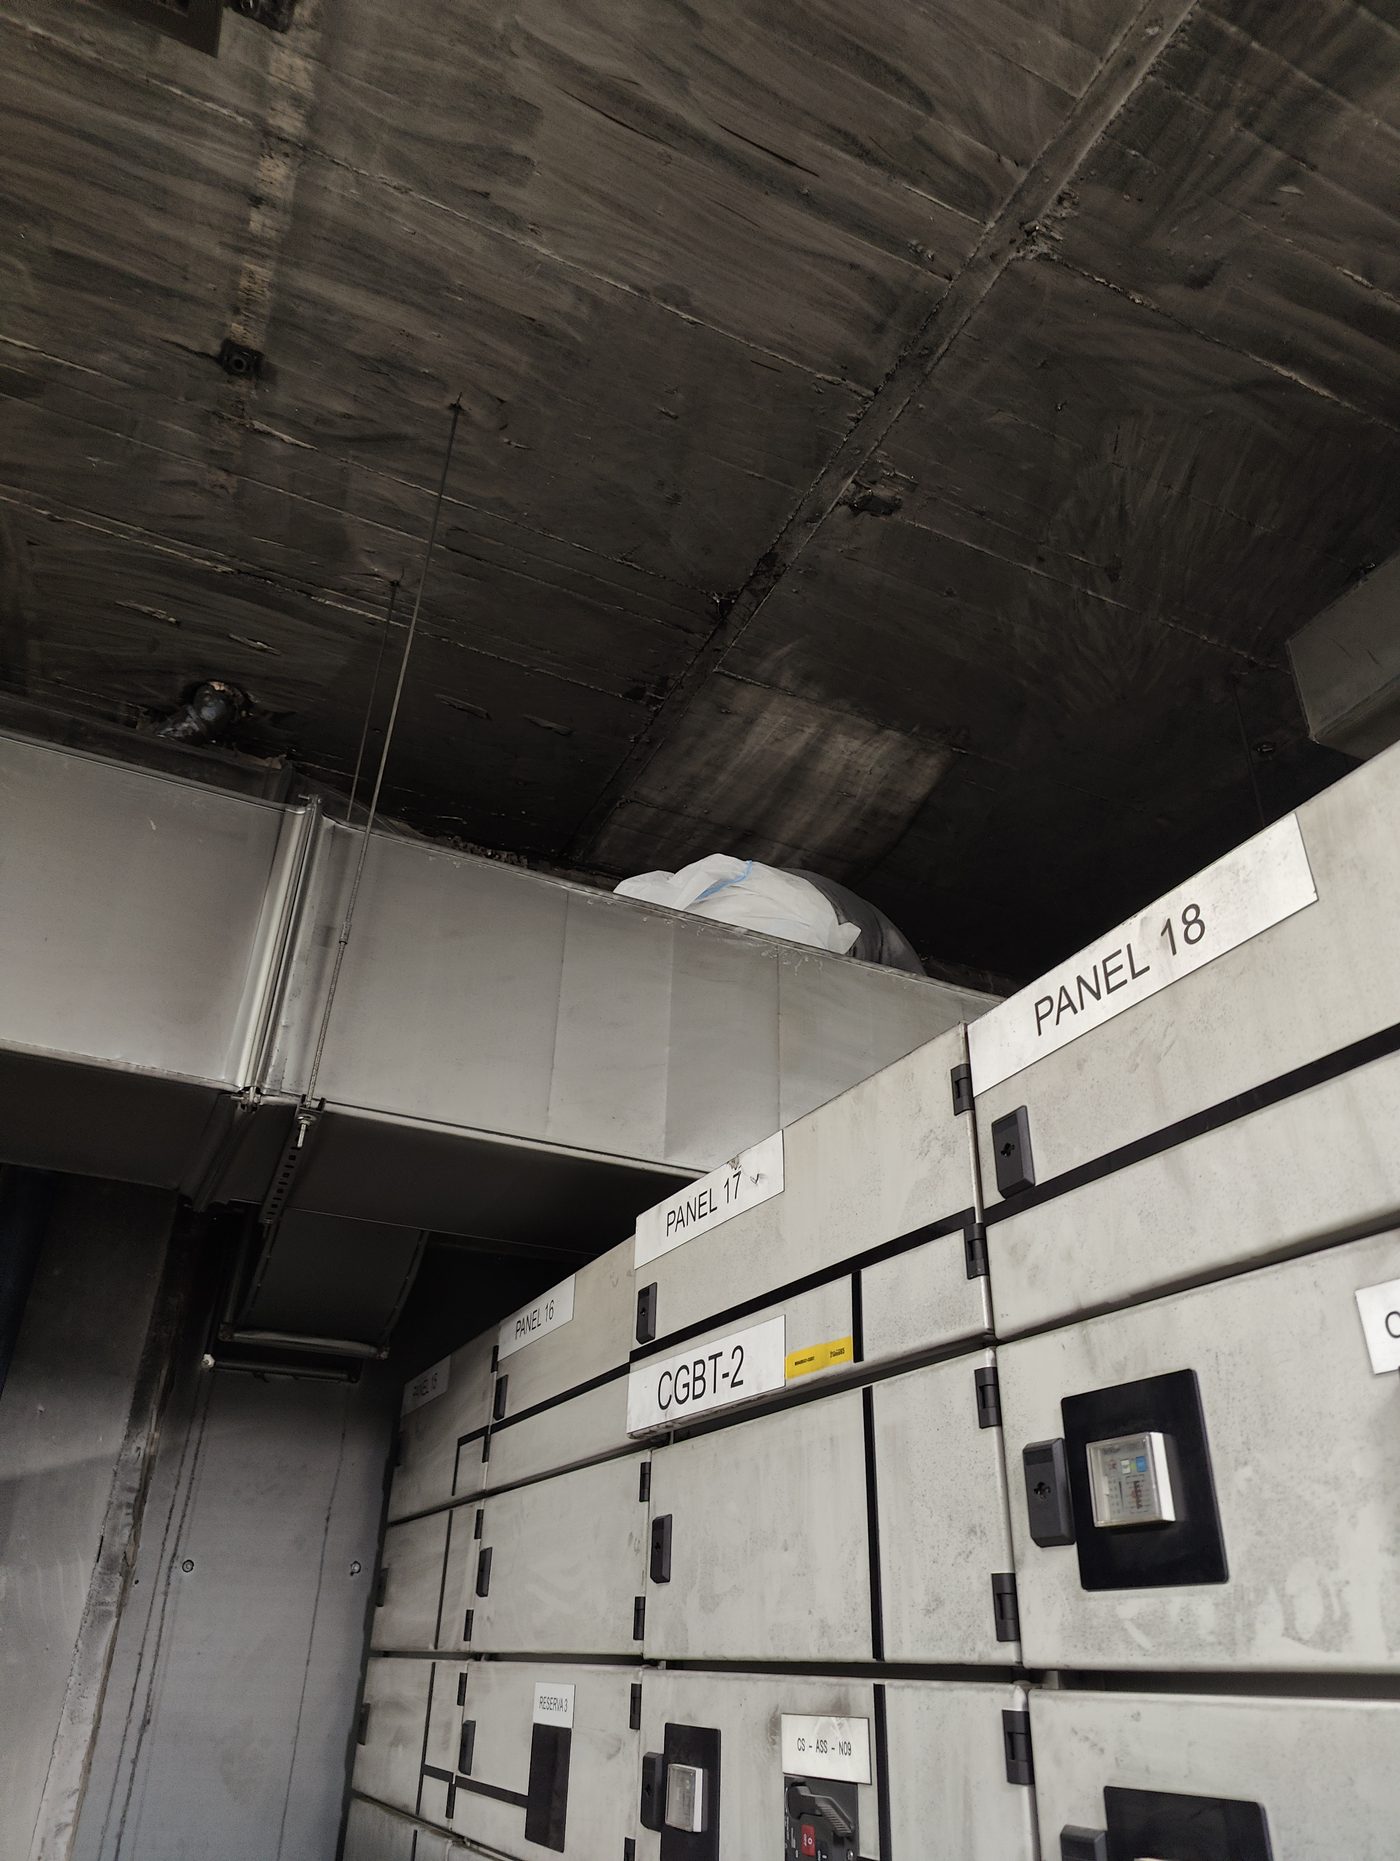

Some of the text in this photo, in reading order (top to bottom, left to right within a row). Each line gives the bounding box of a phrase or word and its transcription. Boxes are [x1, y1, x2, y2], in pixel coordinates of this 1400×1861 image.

[1034, 903, 1206, 1037] PANEL 18
[666, 1170, 742, 1237] PANEL 17
[515, 1299, 554, 1340] PANEL 16
[657, 1345, 744, 1411] CGBT-2
[539, 1695, 563, 1712] RESERVA
[797, 1737, 806, 1752] CS
[815, 1738, 828, 1754] ASS
